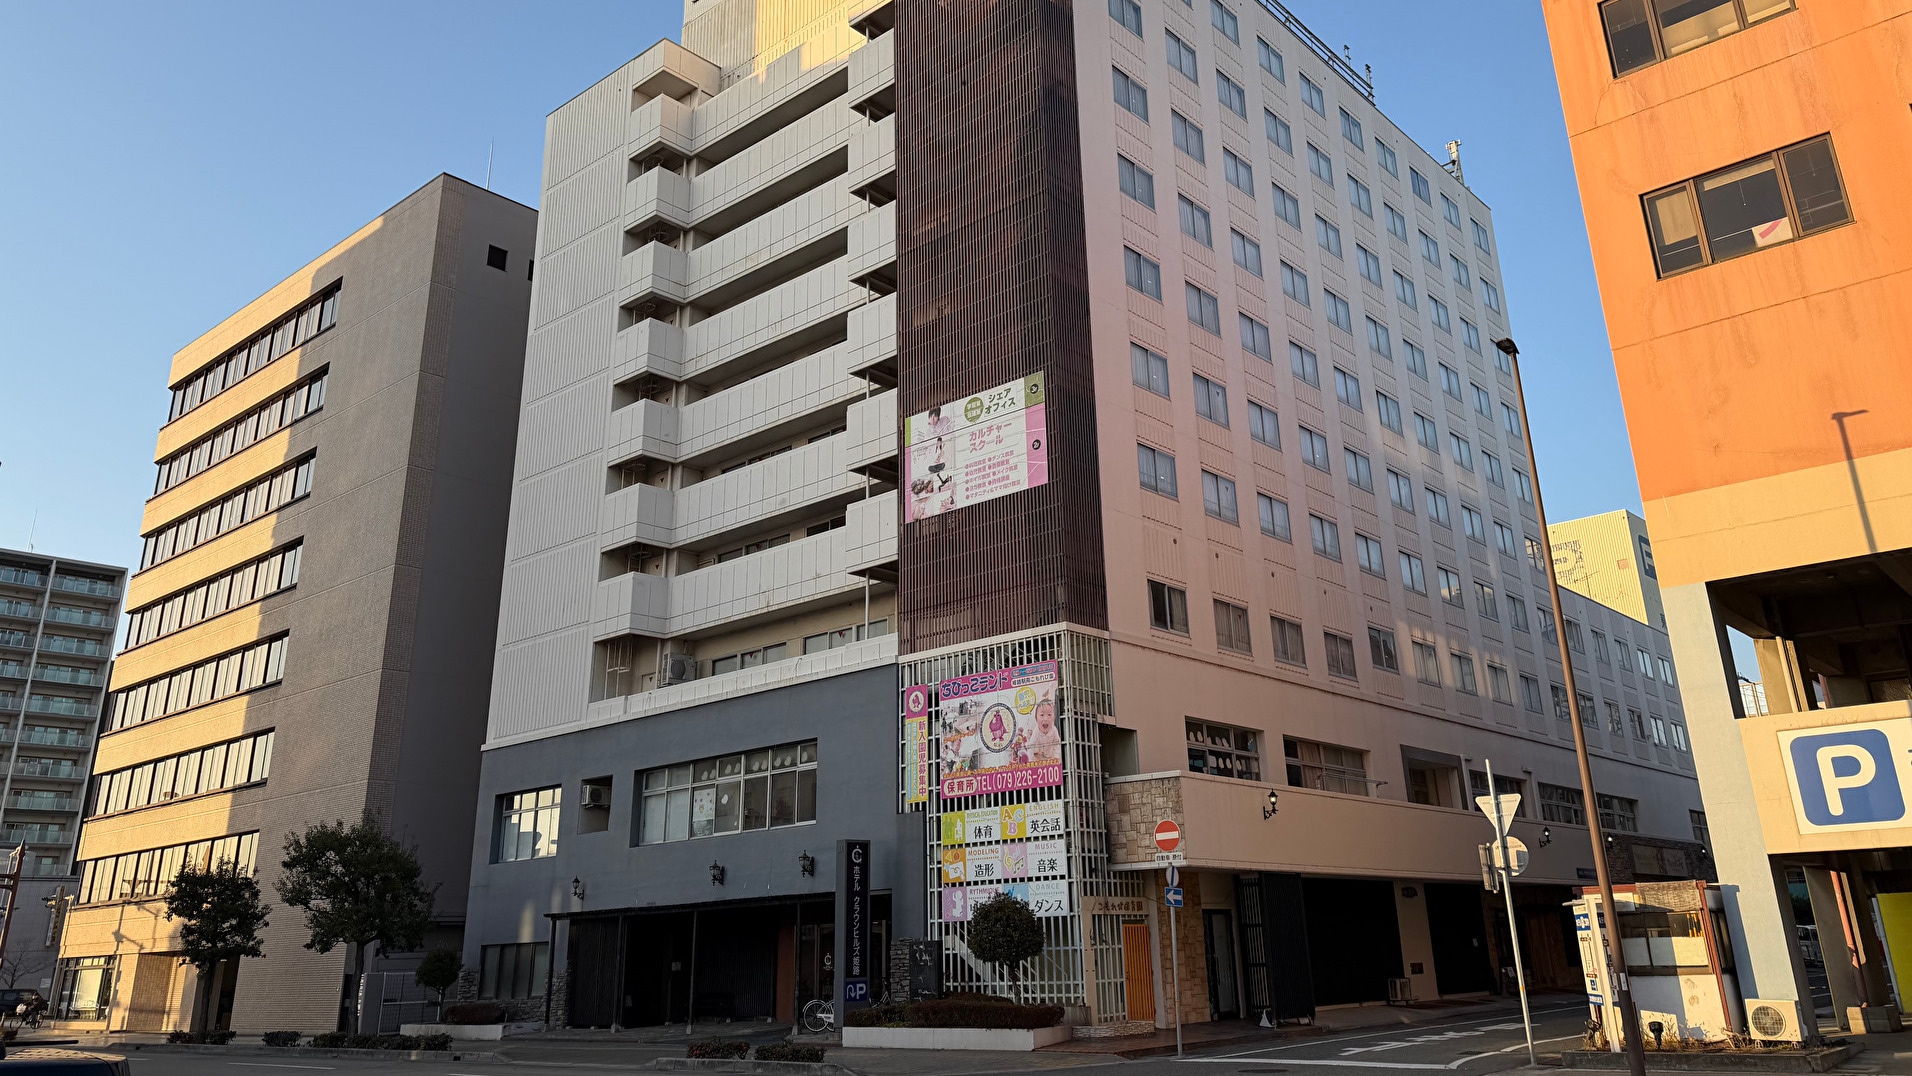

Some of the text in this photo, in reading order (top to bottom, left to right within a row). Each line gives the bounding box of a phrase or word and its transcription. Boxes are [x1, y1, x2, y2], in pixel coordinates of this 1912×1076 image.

[988, 387, 1012, 403] シェア
[984, 396, 1016, 414] オフィス
[969, 422, 1012, 441] カルチャー
[969, 434, 1004, 453] スクール
[941, 672, 1008, 698] ちびっこランド
[918, 720, 927, 797] 新入園児募集中
[947, 780, 975, 794] 保育所
[1816, 744, 1876, 816] P
[1029, 803, 1059, 811] ENGLISH
[974, 825, 993, 839] 体育
[1030, 817, 1061, 834] 英会話
[968, 848, 999, 856] MODELING
[974, 863, 994, 878] 造形
[1037, 858, 1058, 873] 音楽
[1034, 899, 1064, 913] ダンス
[852, 866, 861, 976] ホテル クラウンヒルズ姫路
[856, 984, 867, 999] P
